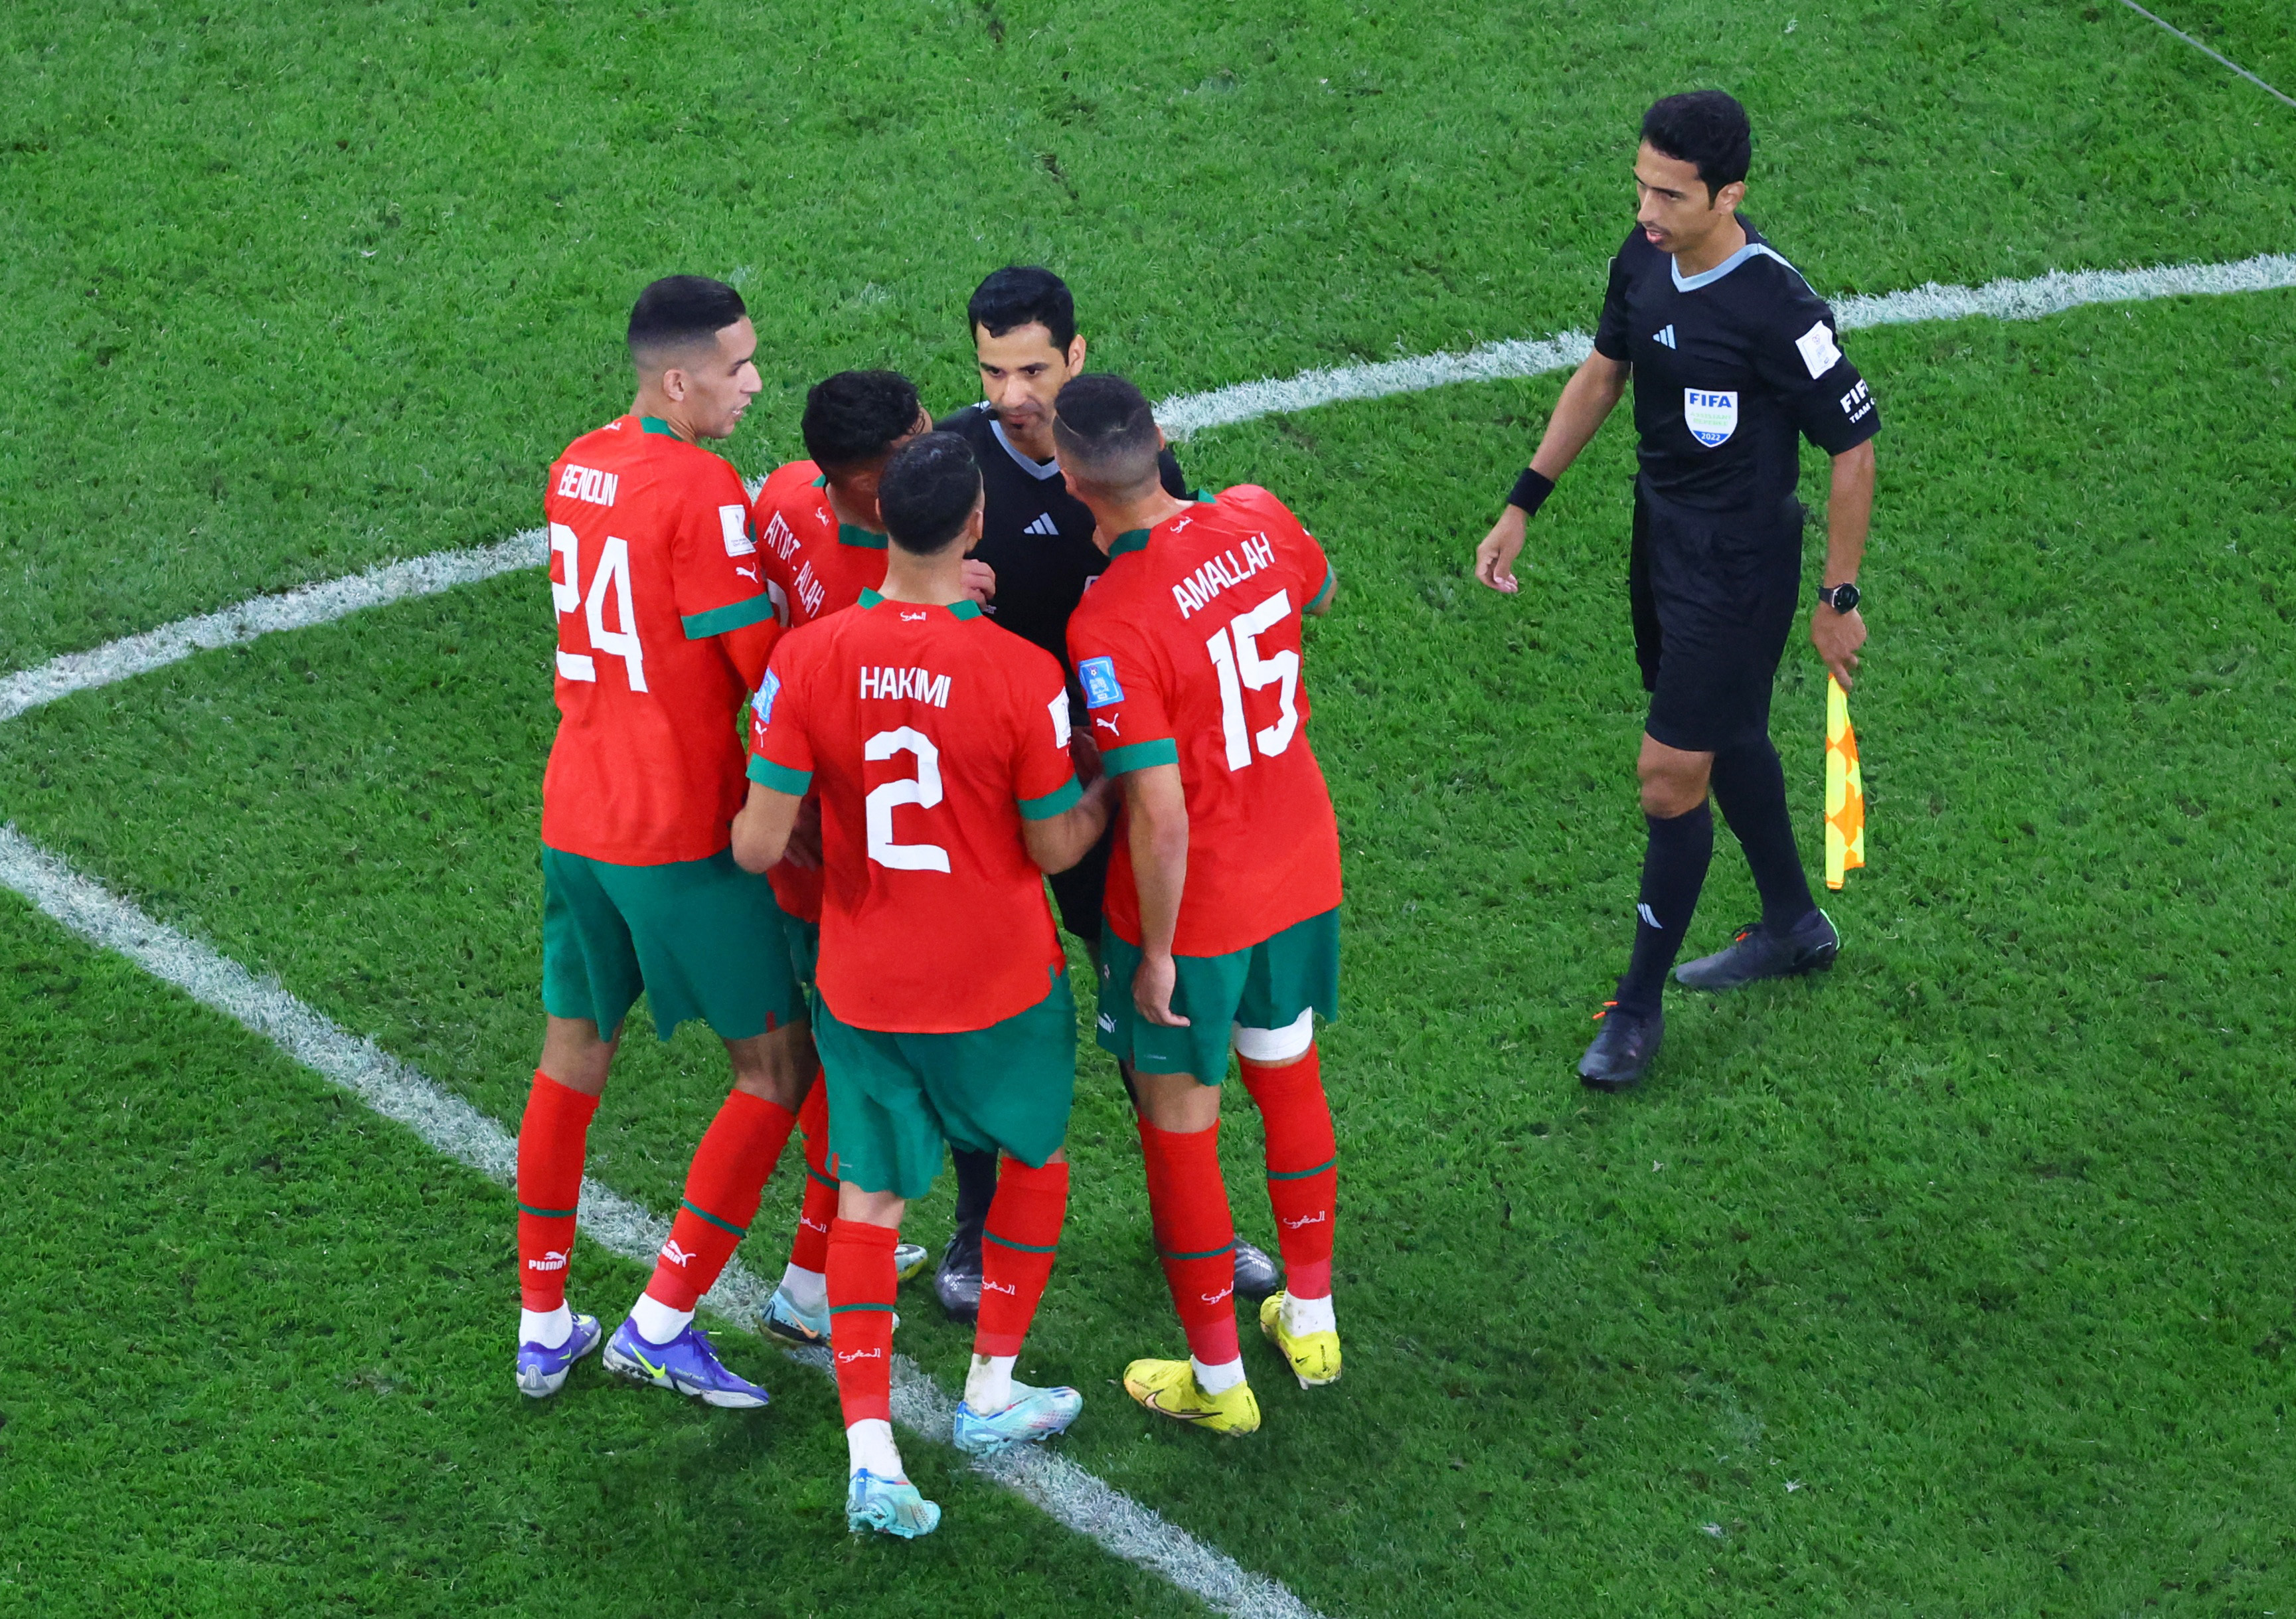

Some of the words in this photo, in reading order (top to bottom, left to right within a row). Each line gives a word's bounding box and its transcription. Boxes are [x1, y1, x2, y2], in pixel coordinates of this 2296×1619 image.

[1690, 392, 1732, 408] FIFA
[1849, 402, 1871, 424] TEAM
[1701, 432, 1721, 442] 2022
[558, 464, 619, 507] BENOUN
[1171, 532, 1275, 620] AMALLAH
[550, 521, 649, 693] 24
[860, 666, 951, 709] HAKIMI
[1206, 588, 1299, 772] 15
[864, 725, 951, 873] 2
